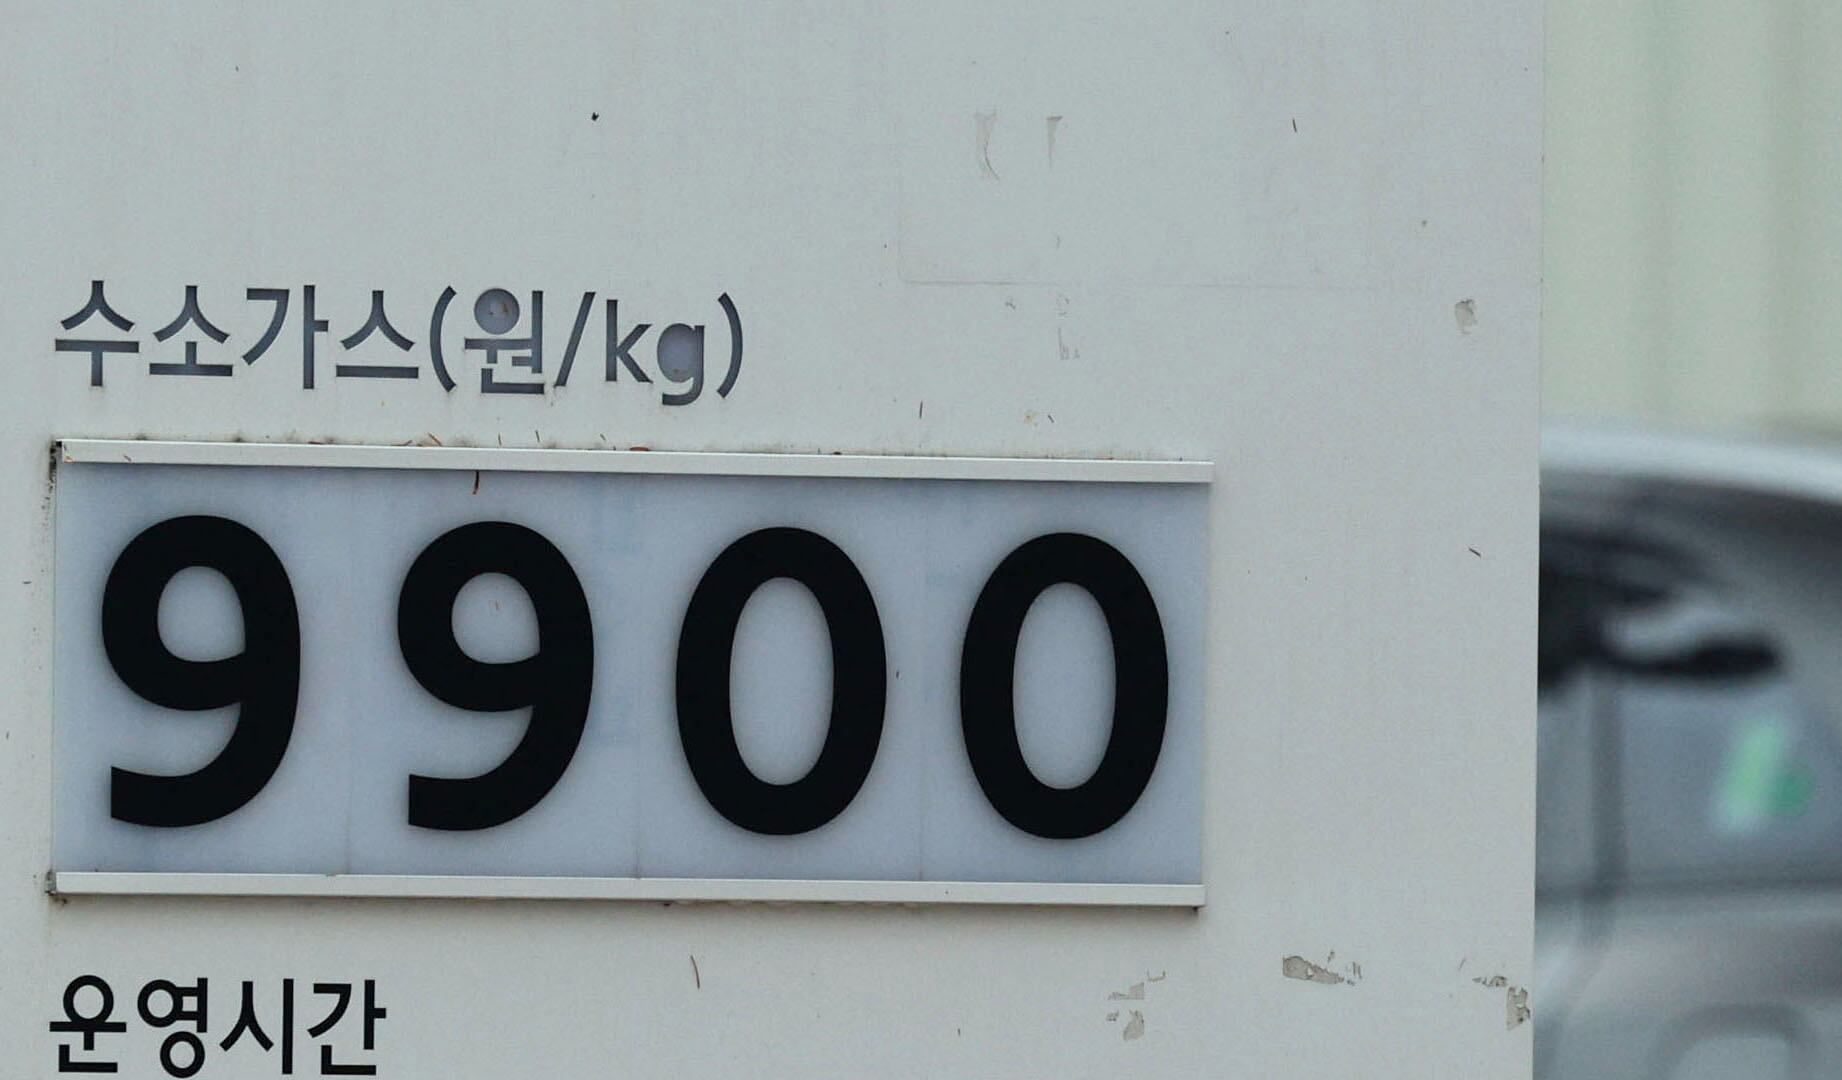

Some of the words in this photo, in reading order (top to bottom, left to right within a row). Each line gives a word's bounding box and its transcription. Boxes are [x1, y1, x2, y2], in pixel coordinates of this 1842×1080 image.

[54, 279, 744, 407] 수소가스(원/kg)
[101, 514, 1169, 841] 9900
[48, 974, 387, 1079] 운영시간
